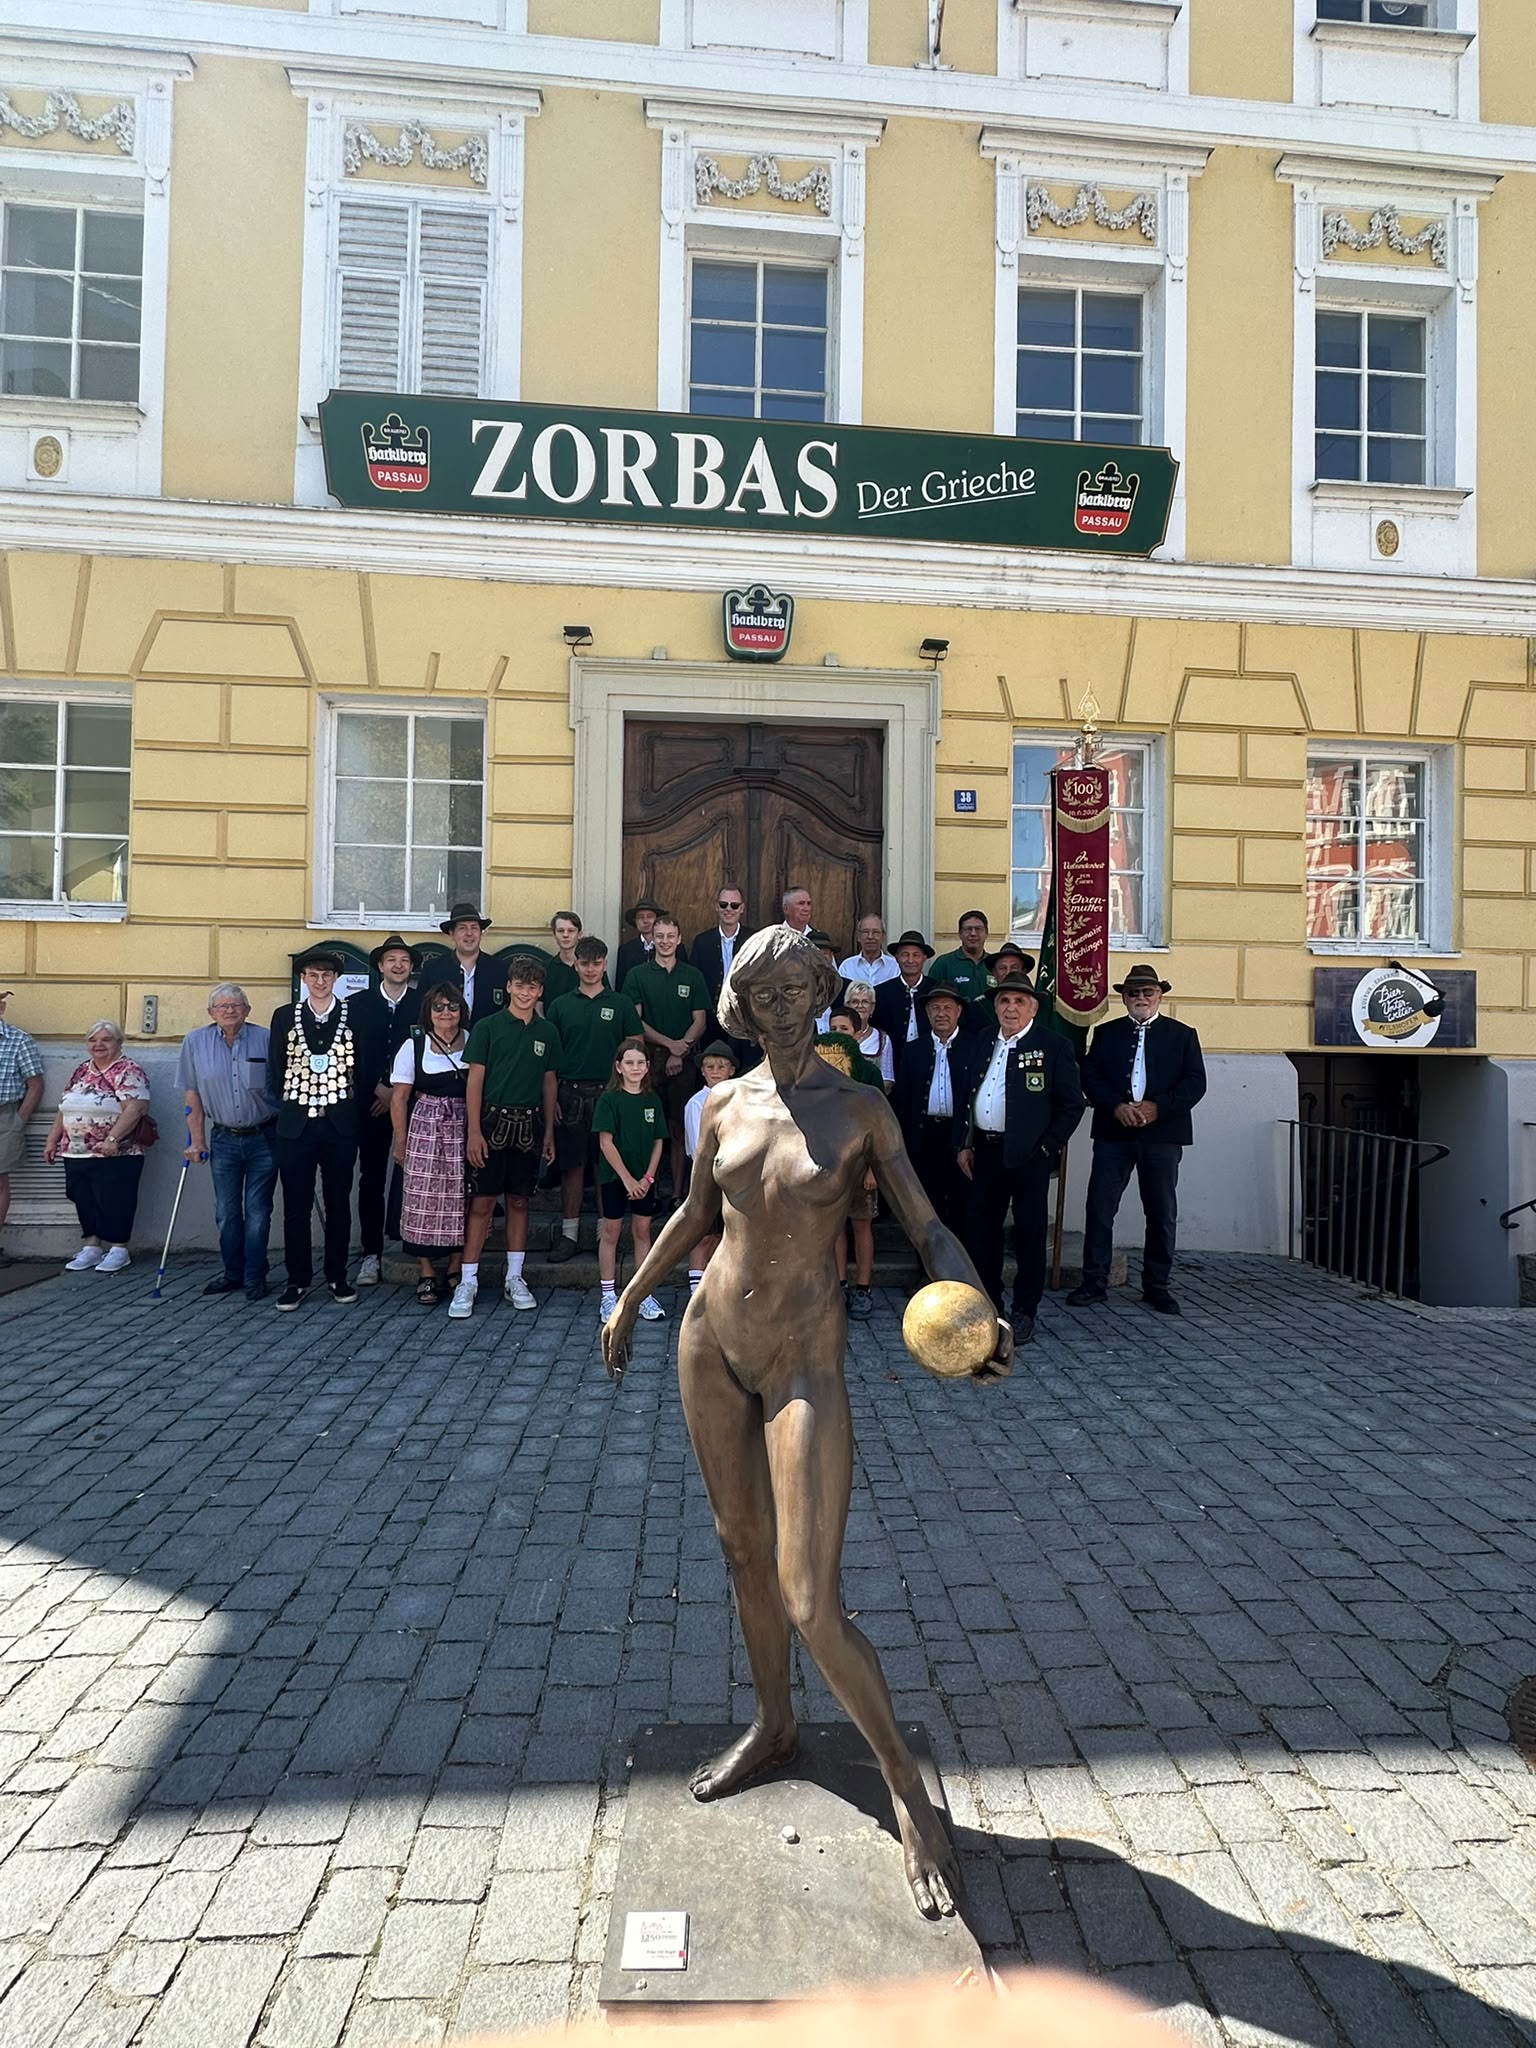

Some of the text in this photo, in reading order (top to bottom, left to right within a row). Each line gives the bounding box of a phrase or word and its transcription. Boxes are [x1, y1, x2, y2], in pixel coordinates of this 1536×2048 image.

[367, 446, 427, 466] Hacklberg
[377, 471, 422, 484] PASSAU
[470, 418, 838, 521] ZORBAS
[857, 462, 1036, 513] Der Grieche
[1078, 492, 1132, 510] Hacklberg
[1081, 515, 1122, 528] PASSAU
[731, 613, 785, 630] Hacklberg
[738, 633, 777, 643] PASSAU
[1073, 781, 1094, 795] 100
[960, 791, 972, 803] 38
[1374, 985, 1405, 1003] Bier-
